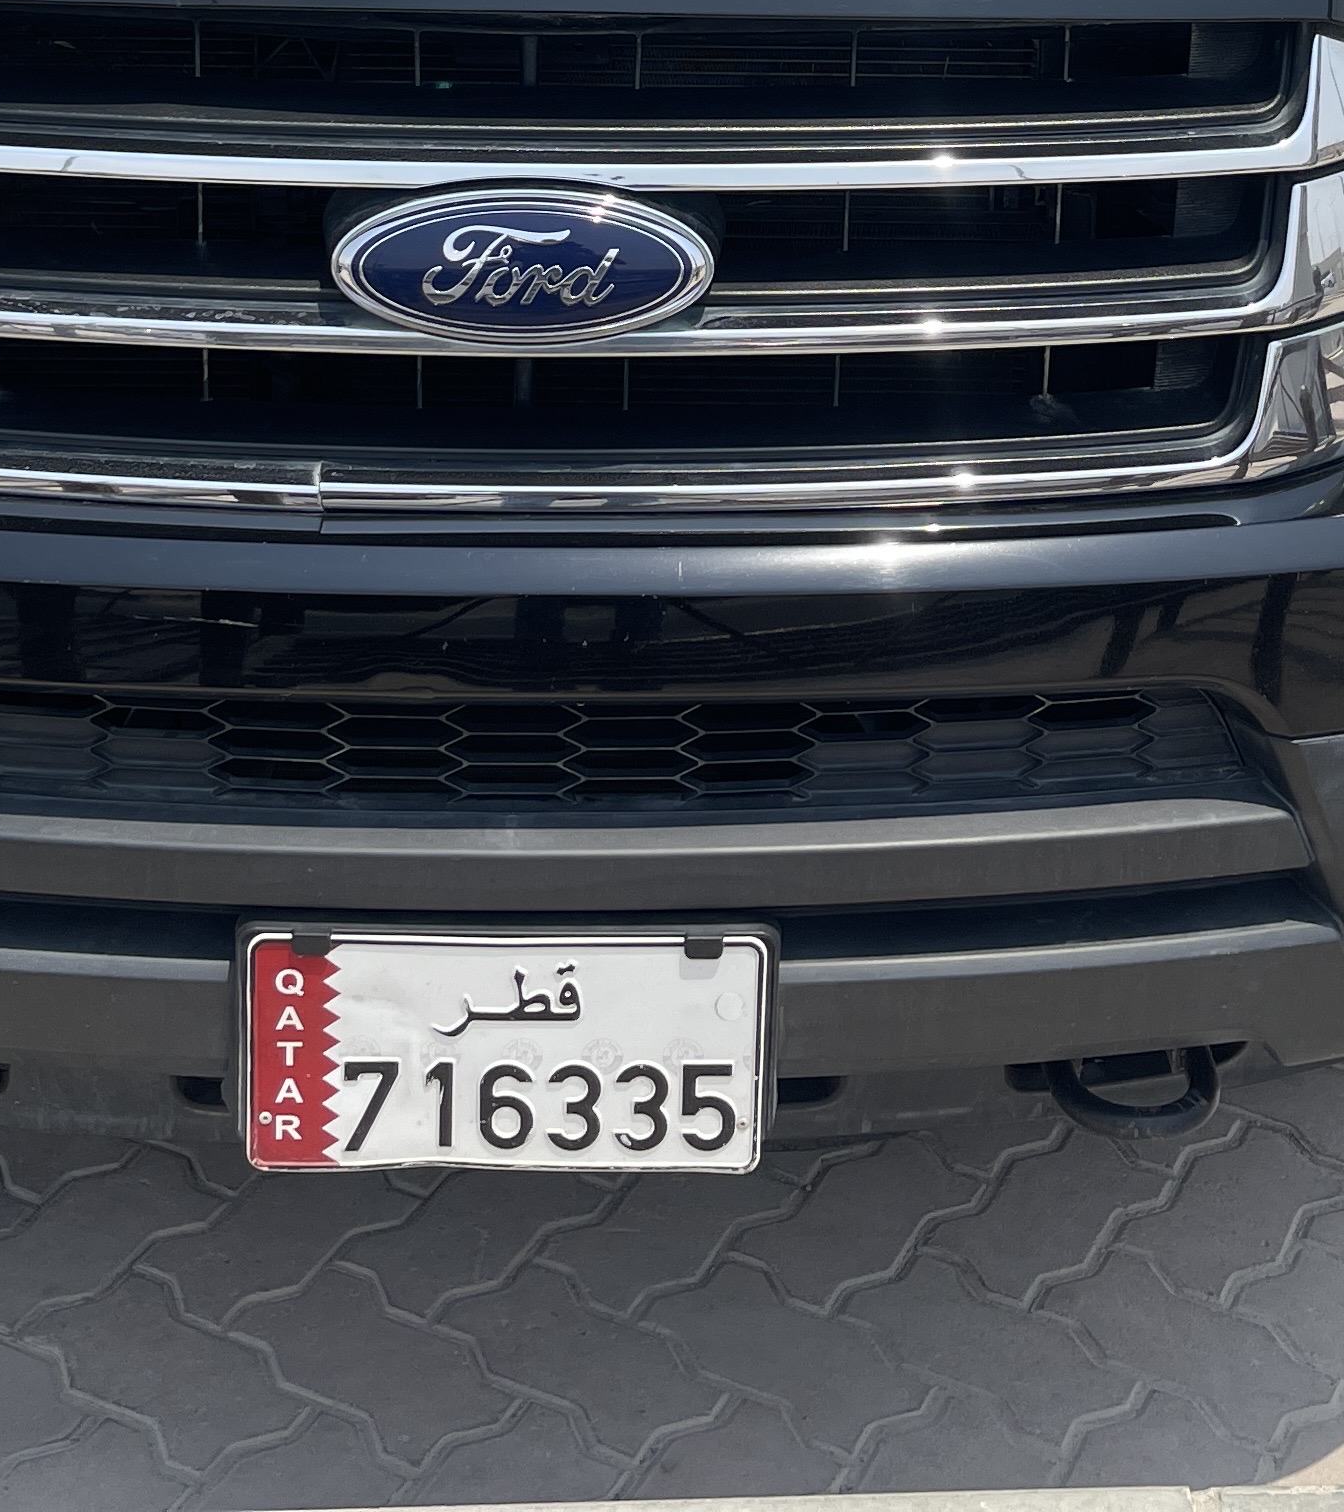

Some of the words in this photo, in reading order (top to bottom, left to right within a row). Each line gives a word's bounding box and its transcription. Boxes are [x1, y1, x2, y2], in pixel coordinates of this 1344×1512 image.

[422, 225, 620, 308] Ford
[431, 959, 584, 1037] قطر
[274, 968, 305, 1141] QATAR
[342, 1059, 738, 1152] 716335
